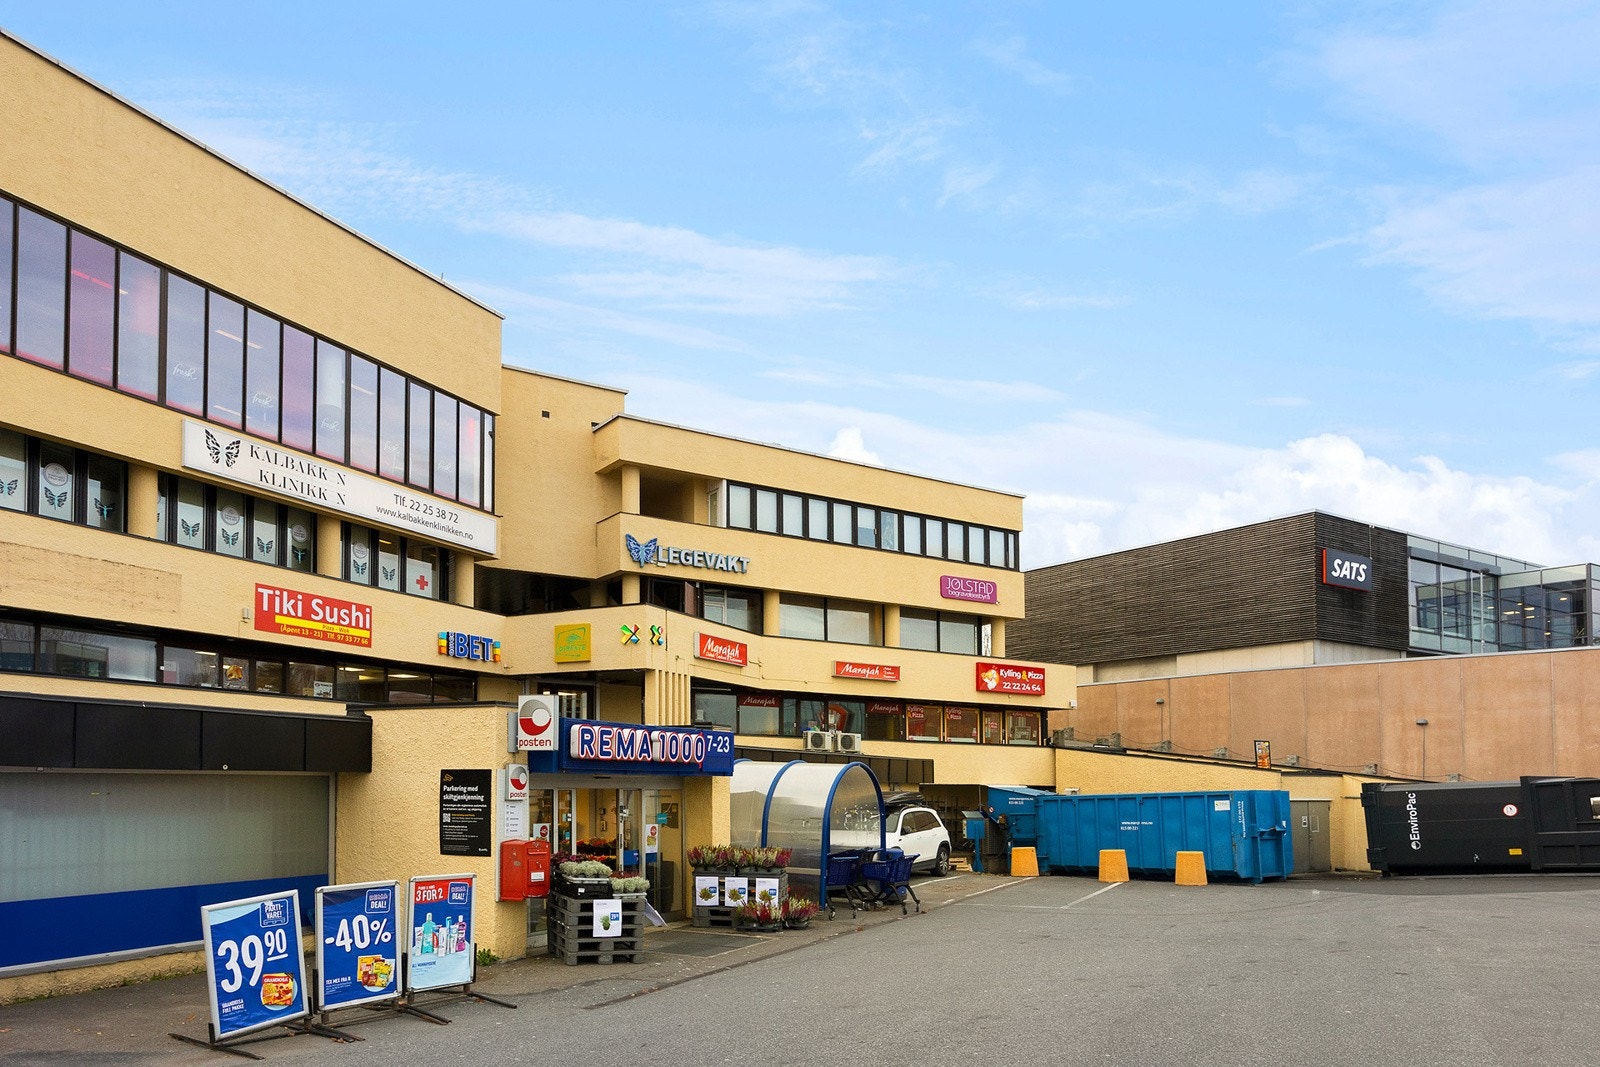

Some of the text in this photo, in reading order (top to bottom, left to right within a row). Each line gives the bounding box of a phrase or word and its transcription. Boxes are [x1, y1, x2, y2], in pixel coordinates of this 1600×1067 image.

[250, 444, 346, 486] KALBAKKN
[259, 469, 346, 506] KLINIKKN
[393, 493, 460, 524] Tlf. 22 25 38 72
[375, 506, 475, 541] www.kalbakkenklinikken.no
[657, 545, 750, 574] LEGEVAKT
[1331, 558, 1368, 582] SATS
[946, 577, 994, 595] JØLSTAD
[257, 587, 371, 629] Tiki Sushi
[280, 623, 301, 634] (Åpent
[337, 633, 345, 641] 97
[455, 631, 494, 662] BET
[703, 637, 740, 661] Marajah
[840, 663, 881, 678] Marajah
[999, 668, 1044, 682] Kylling & Pizza
[1002, 681, 1041, 692] 22 22 24 64
[518, 737, 552, 748] posten
[577, 724, 730, 764] REMA 1000 7-23
[443, 785, 467, 793] Parkering
[1406, 792, 1420, 840] EnviroPac
[370, 900, 387, 909] DEAL!
[415, 890, 422, 902] 3
[422, 889, 438, 901] FOR
[437, 887, 444, 899] 2
[451, 892, 465, 900] DEAL!
[325, 914, 392, 953] -40%
[217, 928, 288, 993] 39 90
